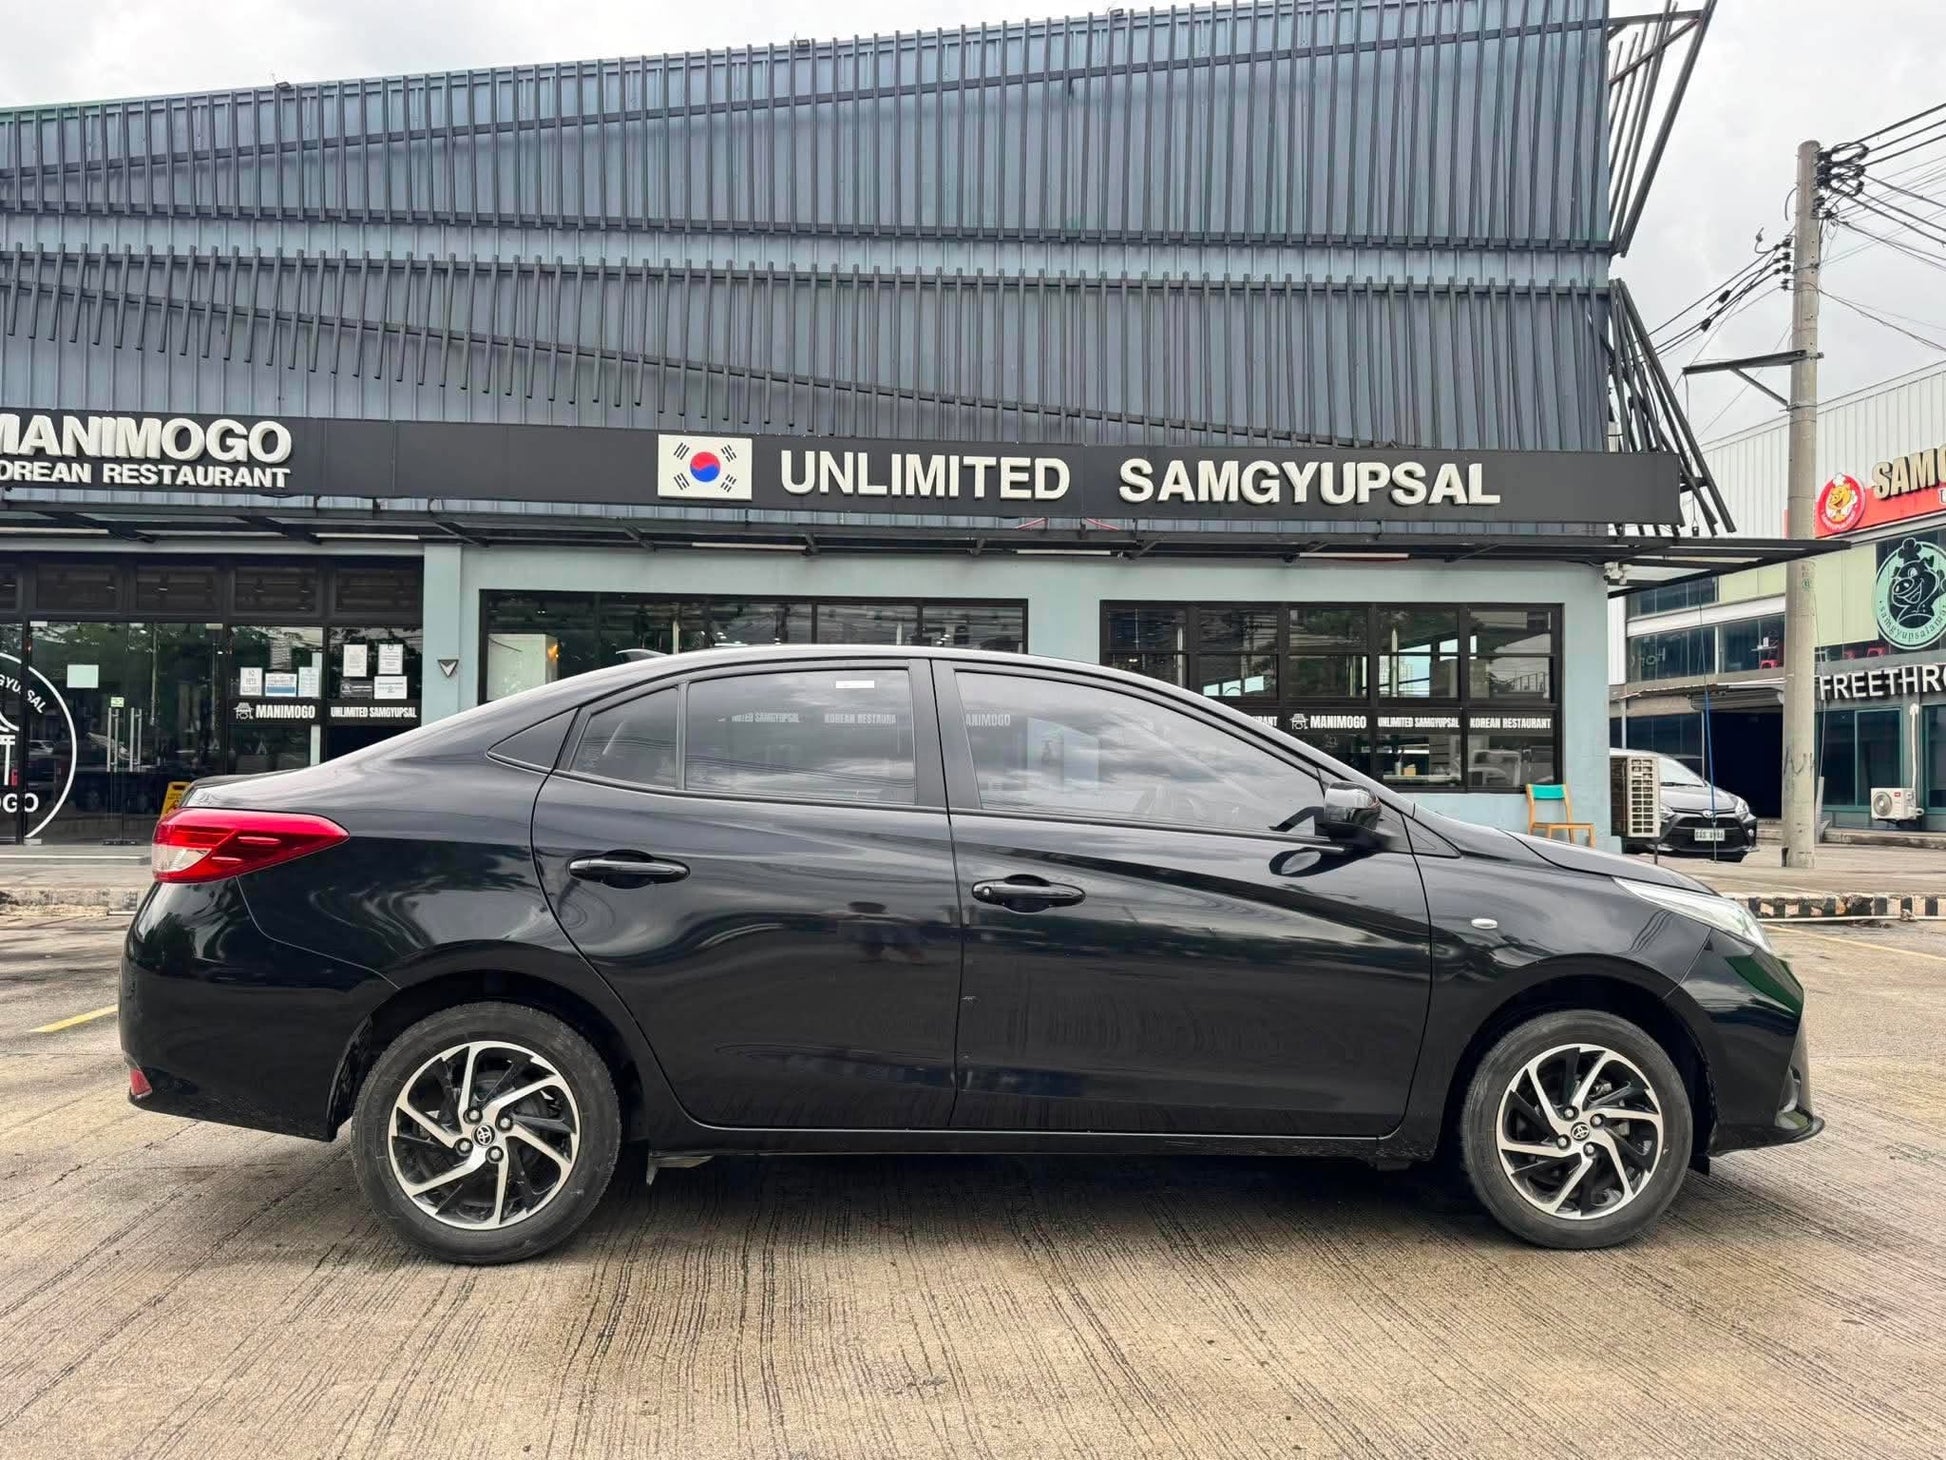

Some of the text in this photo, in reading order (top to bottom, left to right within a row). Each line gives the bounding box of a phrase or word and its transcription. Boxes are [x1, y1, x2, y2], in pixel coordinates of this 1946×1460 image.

[102, 464, 291, 488] RESTAURANT
[780, 449, 1500, 505] UNLIMITED SAMGYUPSAL
[256, 704, 316, 719] MANIMOGO
[330, 706, 417, 718] UNLIMITED SAMGYUPSAL
[1310, 715, 1367, 729] MANIMOGO
[1377, 716, 1460, 728] UNLIMITED SAMGYUPSAL
[1469, 717, 1552, 729] KOREAN RESTAURANT
